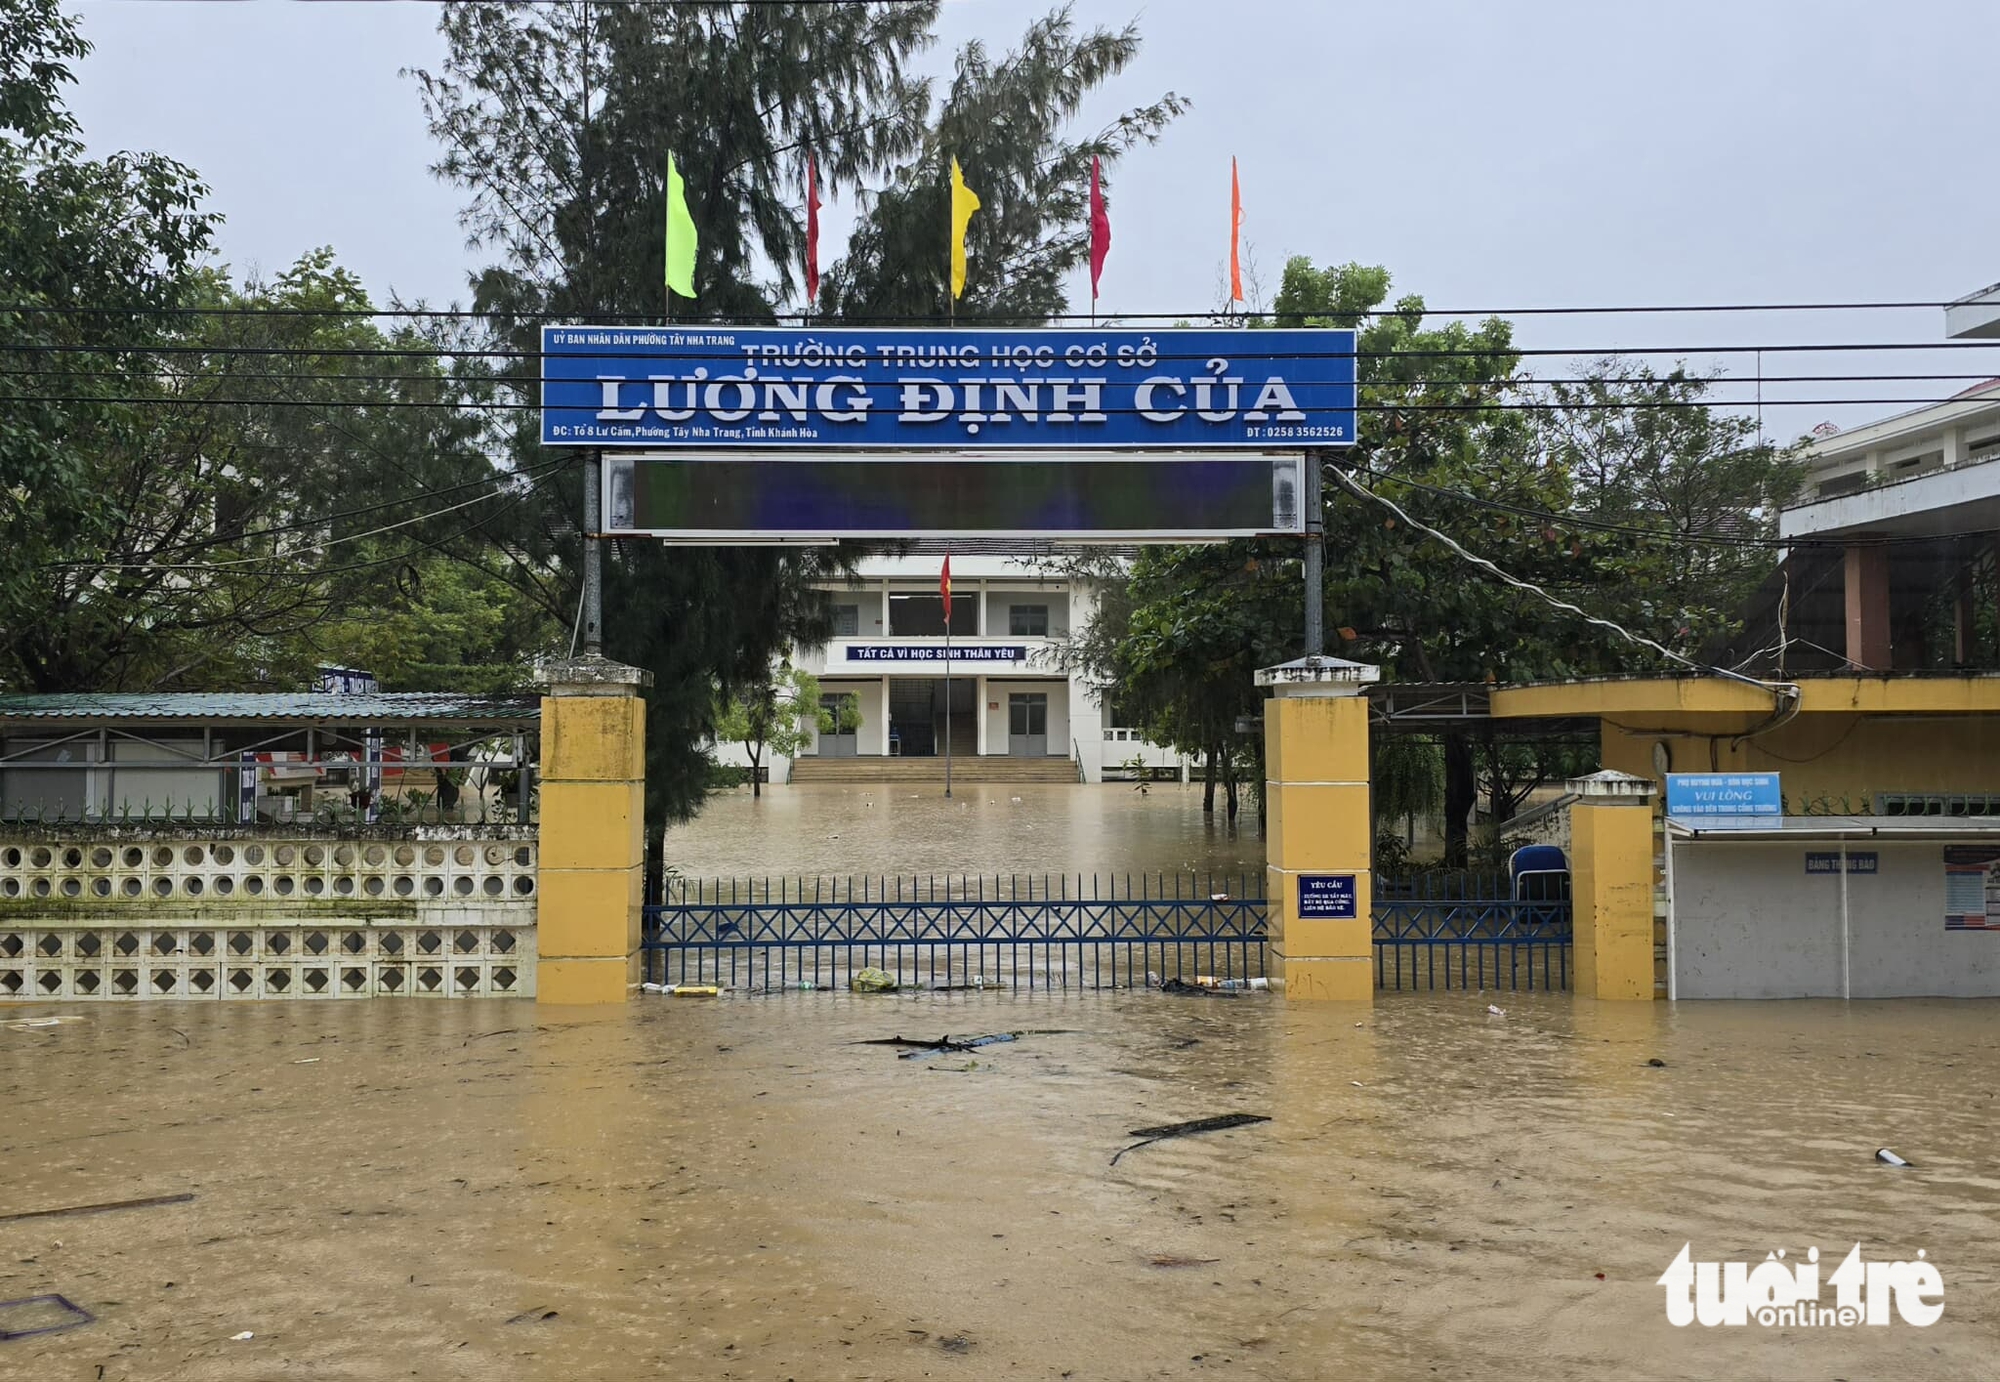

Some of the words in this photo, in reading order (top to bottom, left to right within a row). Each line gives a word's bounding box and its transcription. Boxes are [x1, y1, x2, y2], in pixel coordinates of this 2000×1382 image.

[567, 334, 585, 345] BAN
[587, 333, 610, 345] NHÂN
[613, 333, 630, 345] DÂN
[633, 333, 667, 346] PHƯỜNG
[670, 333, 684, 346] TÂY
[687, 335, 704, 346] NHA
[705, 335, 735, 346] TRANG
[741, 338, 867, 368] TRƯỜNG
[876, 344, 979, 368] TRUNG
[992, 344, 1054, 373] HỌC
[1065, 342, 1108, 368] CƠ
[1117, 336, 1157, 368] SỞ
[596, 366, 874, 423] LƯƠNG
[898, 376, 1107, 435] ĐỊNH
[1134, 358, 1306, 423] CỦA
[553, 425, 572, 436] ĐC:
[573, 423, 587, 436] Tổ
[587, 425, 594, 436] 8
[596, 425, 609, 436] Lư
[673, 426, 689, 438] Tây
[692, 427, 710, 437] Nha
[713, 427, 744, 439] Trang,
[745, 425, 766, 438] Tỉnh
[768, 426, 797, 438] Khánh
[799, 426, 818, 438] Hòa
[1296, 426, 1343, 437] 3562526
[858, 645, 878, 659] TẤT
[880, 646, 895, 659] CẢ
[896, 646, 908, 659] VÌ
[911, 649, 934, 661] HỌC
[936, 649, 961, 659] SINH
[963, 648, 991, 659] THÂN
[994, 648, 1015, 659] YÊU
[1695, 791, 1715, 801] VUI
[1718, 789, 1752, 800] LÒNG
[1831, 859, 1857, 870] THNG
[1311, 880, 1326, 889] YÊU
